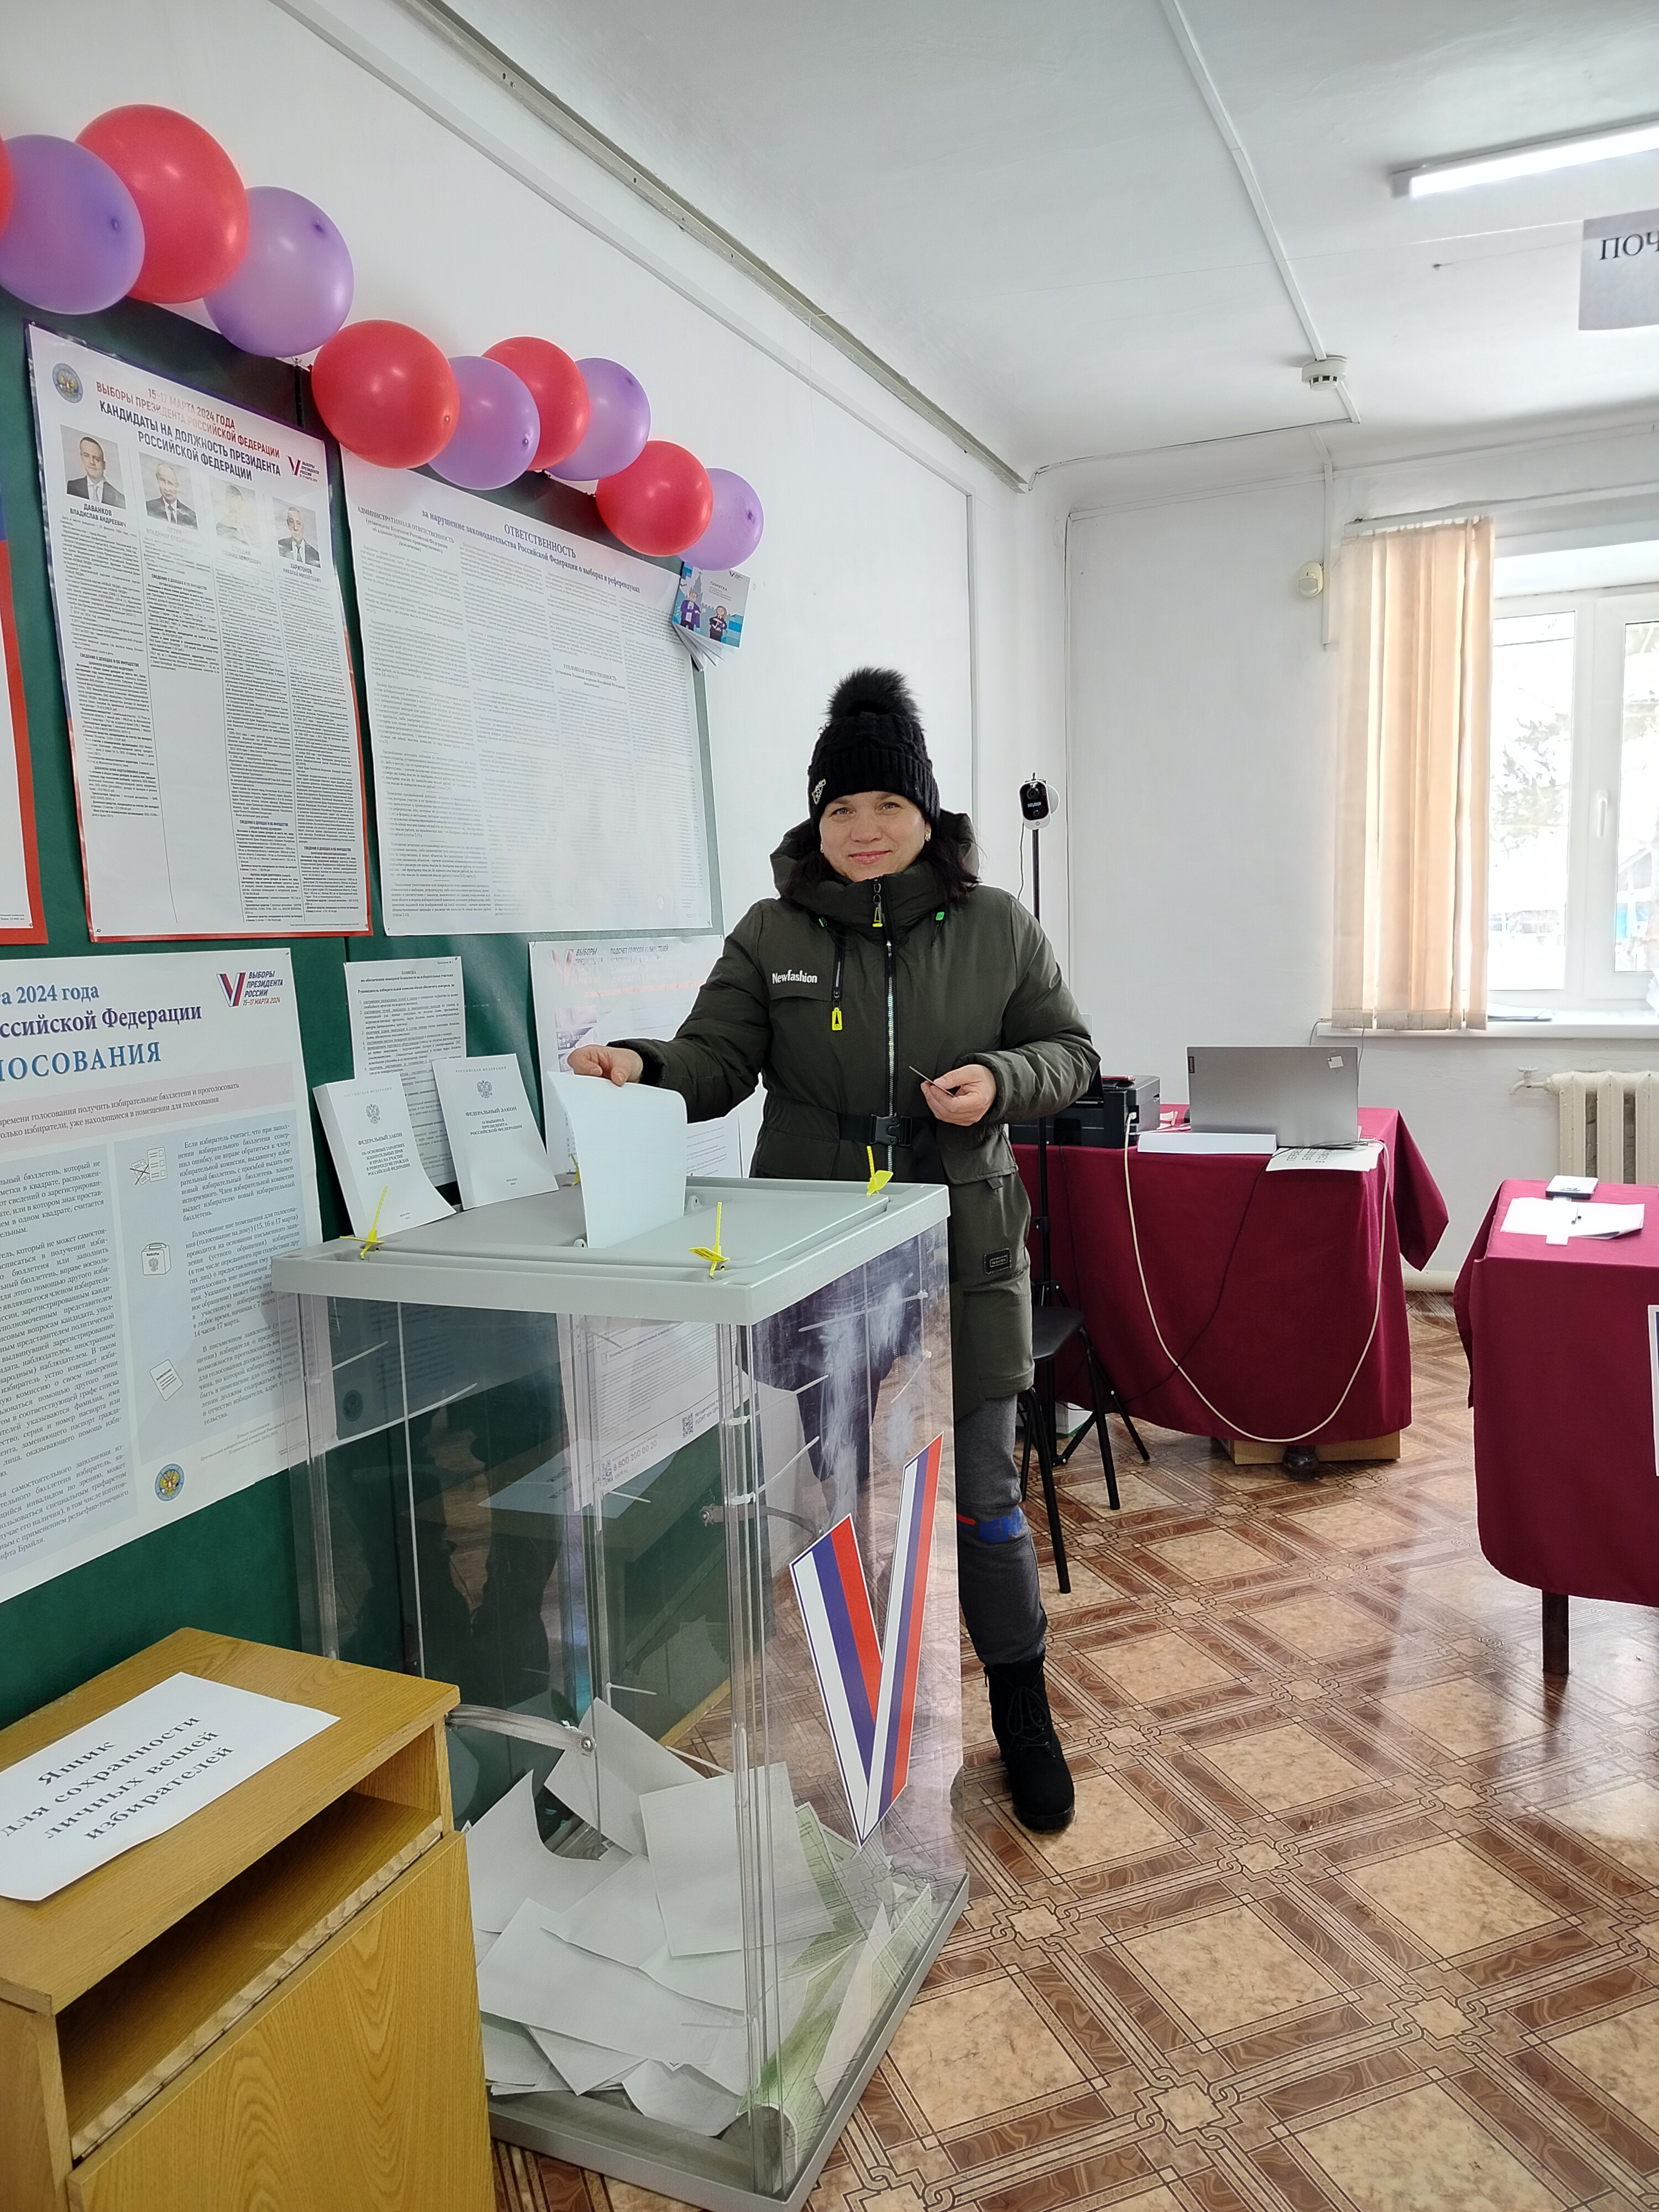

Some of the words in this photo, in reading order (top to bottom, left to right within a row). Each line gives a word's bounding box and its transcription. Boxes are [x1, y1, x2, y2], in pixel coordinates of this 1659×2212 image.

[96, 382, 133, 404] ВЫБОРЫ
[135, 397, 186, 424] ПРЕЗИДЕНТА
[188, 415, 236, 443] РОССИЙСКОЙ
[237, 435, 280, 458] ФЕДЕРАЦИИ
[197, 406, 215, 421] 2024
[216, 414, 235, 429] ГОДА
[100, 400, 158, 432] КАНДИДАТЫ
[160, 422, 173, 437] НА
[175, 428, 228, 457] ДОЛЖНОСТЬ
[229, 448, 280, 476] ПРЕЗИДЕНТА
[138, 430, 199, 462] РОССИЙСКОЙ
[201, 453, 252, 481] ФЕДЕРАЦИИ
[70, 508, 98, 520] ВЛАДИСЛАВ
[100, 515, 126, 528] АНДРЕЕВИЧ
[84, 503, 112, 516] ДАВАНКОВ
[357, 506, 411, 529] АДМИНИСТРАТИВНАЯ
[411, 525, 455, 544] ОТВЕТСТВЕННОСТЬ
[421, 509, 429, 518] за
[430, 512, 465, 531] нарушение
[466, 526, 517, 550] законодательства
[518, 542, 549, 561] Российской
[549, 554, 578, 572] Федерации
[583, 567, 603, 582] выборах
[608, 577, 640, 593] референдумах
[504, 524, 576, 559] ОТВЕТСТВЕННОСТЬ
[290, 563, 312, 574] ХАРИТОНОВ
[710, 581, 728, 592] ПАМЯТКА
[576, 948, 598, 956] ВЫБОРЫ
[611, 947, 628, 956] ПОДСЧЕТ
[247, 979, 283, 988] ПРЕЗИДЕНТА
[249, 971, 275, 979] ВЫБОРЫ
[772, 969, 817, 984] Newfashion
[15, 984, 58, 1004] 2024
[61, 985, 100, 1002] года
[244, 989, 268, 998] РОССИИ
[0, 1010, 97, 1038] ссийской
[102, 1006, 202, 1030] Федерации
[32, 1108, 76, 1121] голосования
[78, 1103, 110, 1114] получить
[112, 1095, 158, 1108] избирательные
[159, 1090, 191, 1100] бюллетени
[198, 1083, 239, 1095] проголосовать
[466, 1108, 500, 1117] ФЕДЕРАЛЬНЫЙ
[24, 1121, 68, 1134] избиратели,
[70, 1119, 84, 1129] уже
[85, 1112, 129, 1125] находящиеся
[135, 1105, 170, 1116] помещении
[183, 1097, 219, 1108] голосования
[184, 1140, 198, 1149] Если
[200, 1135, 229, 1145] избиратель
[358, 1134, 388, 1145] ФЕДЕРАЛЬНЫЙ
[192, 1155, 213, 1165] ошибку,
[242, 1144, 270, 1156] обратиться
[276, 1140, 291, 1149] члену
[367, 1151, 394, 1160] ИЗБИРАТЕЛЬНЫХ
[24, 1169, 61, 1181] бюллетень,
[64, 1161, 90, 1173] который
[368, 1167, 390, 1176] РОССИЙСКОЙ
[390, 1163, 410, 1172] ФЕДЕРАЦИИ
[29, 1178, 60, 1190] квадрате,
[62, 1171, 101, 1185] расположен-
[9, 1192, 40, 1204] сведений
[48, 1181, 102, 1196] зарегистрирован-
[183, 1211, 212, 1222] бюллетень.
[618, 1457, 629, 1468] 800
[631, 1450, 640, 1461] 200
[642, 1445, 649, 1454] 00
[650, 1440, 657, 1449] 20
[11, 1466, 72, 1494] самостоятельного
[76, 1450, 111, 1468] заполнения
[46, 1488, 88, 1510] специальным
[91, 1472, 127, 1491] трафаретом
[68, 1490, 129, 1523] рельефно-точечного
[18, 1537, 45, 1553] Брайля.
[37, 1740, 116, 1786] Ящик
[0, 1804, 51, 1837] для
[54, 1717, 201, 1804] сохранности
[45, 1776, 145, 1839] личных
[145, 1729, 220, 1775] вещей
[83, 1745, 235, 1841] избирателей
